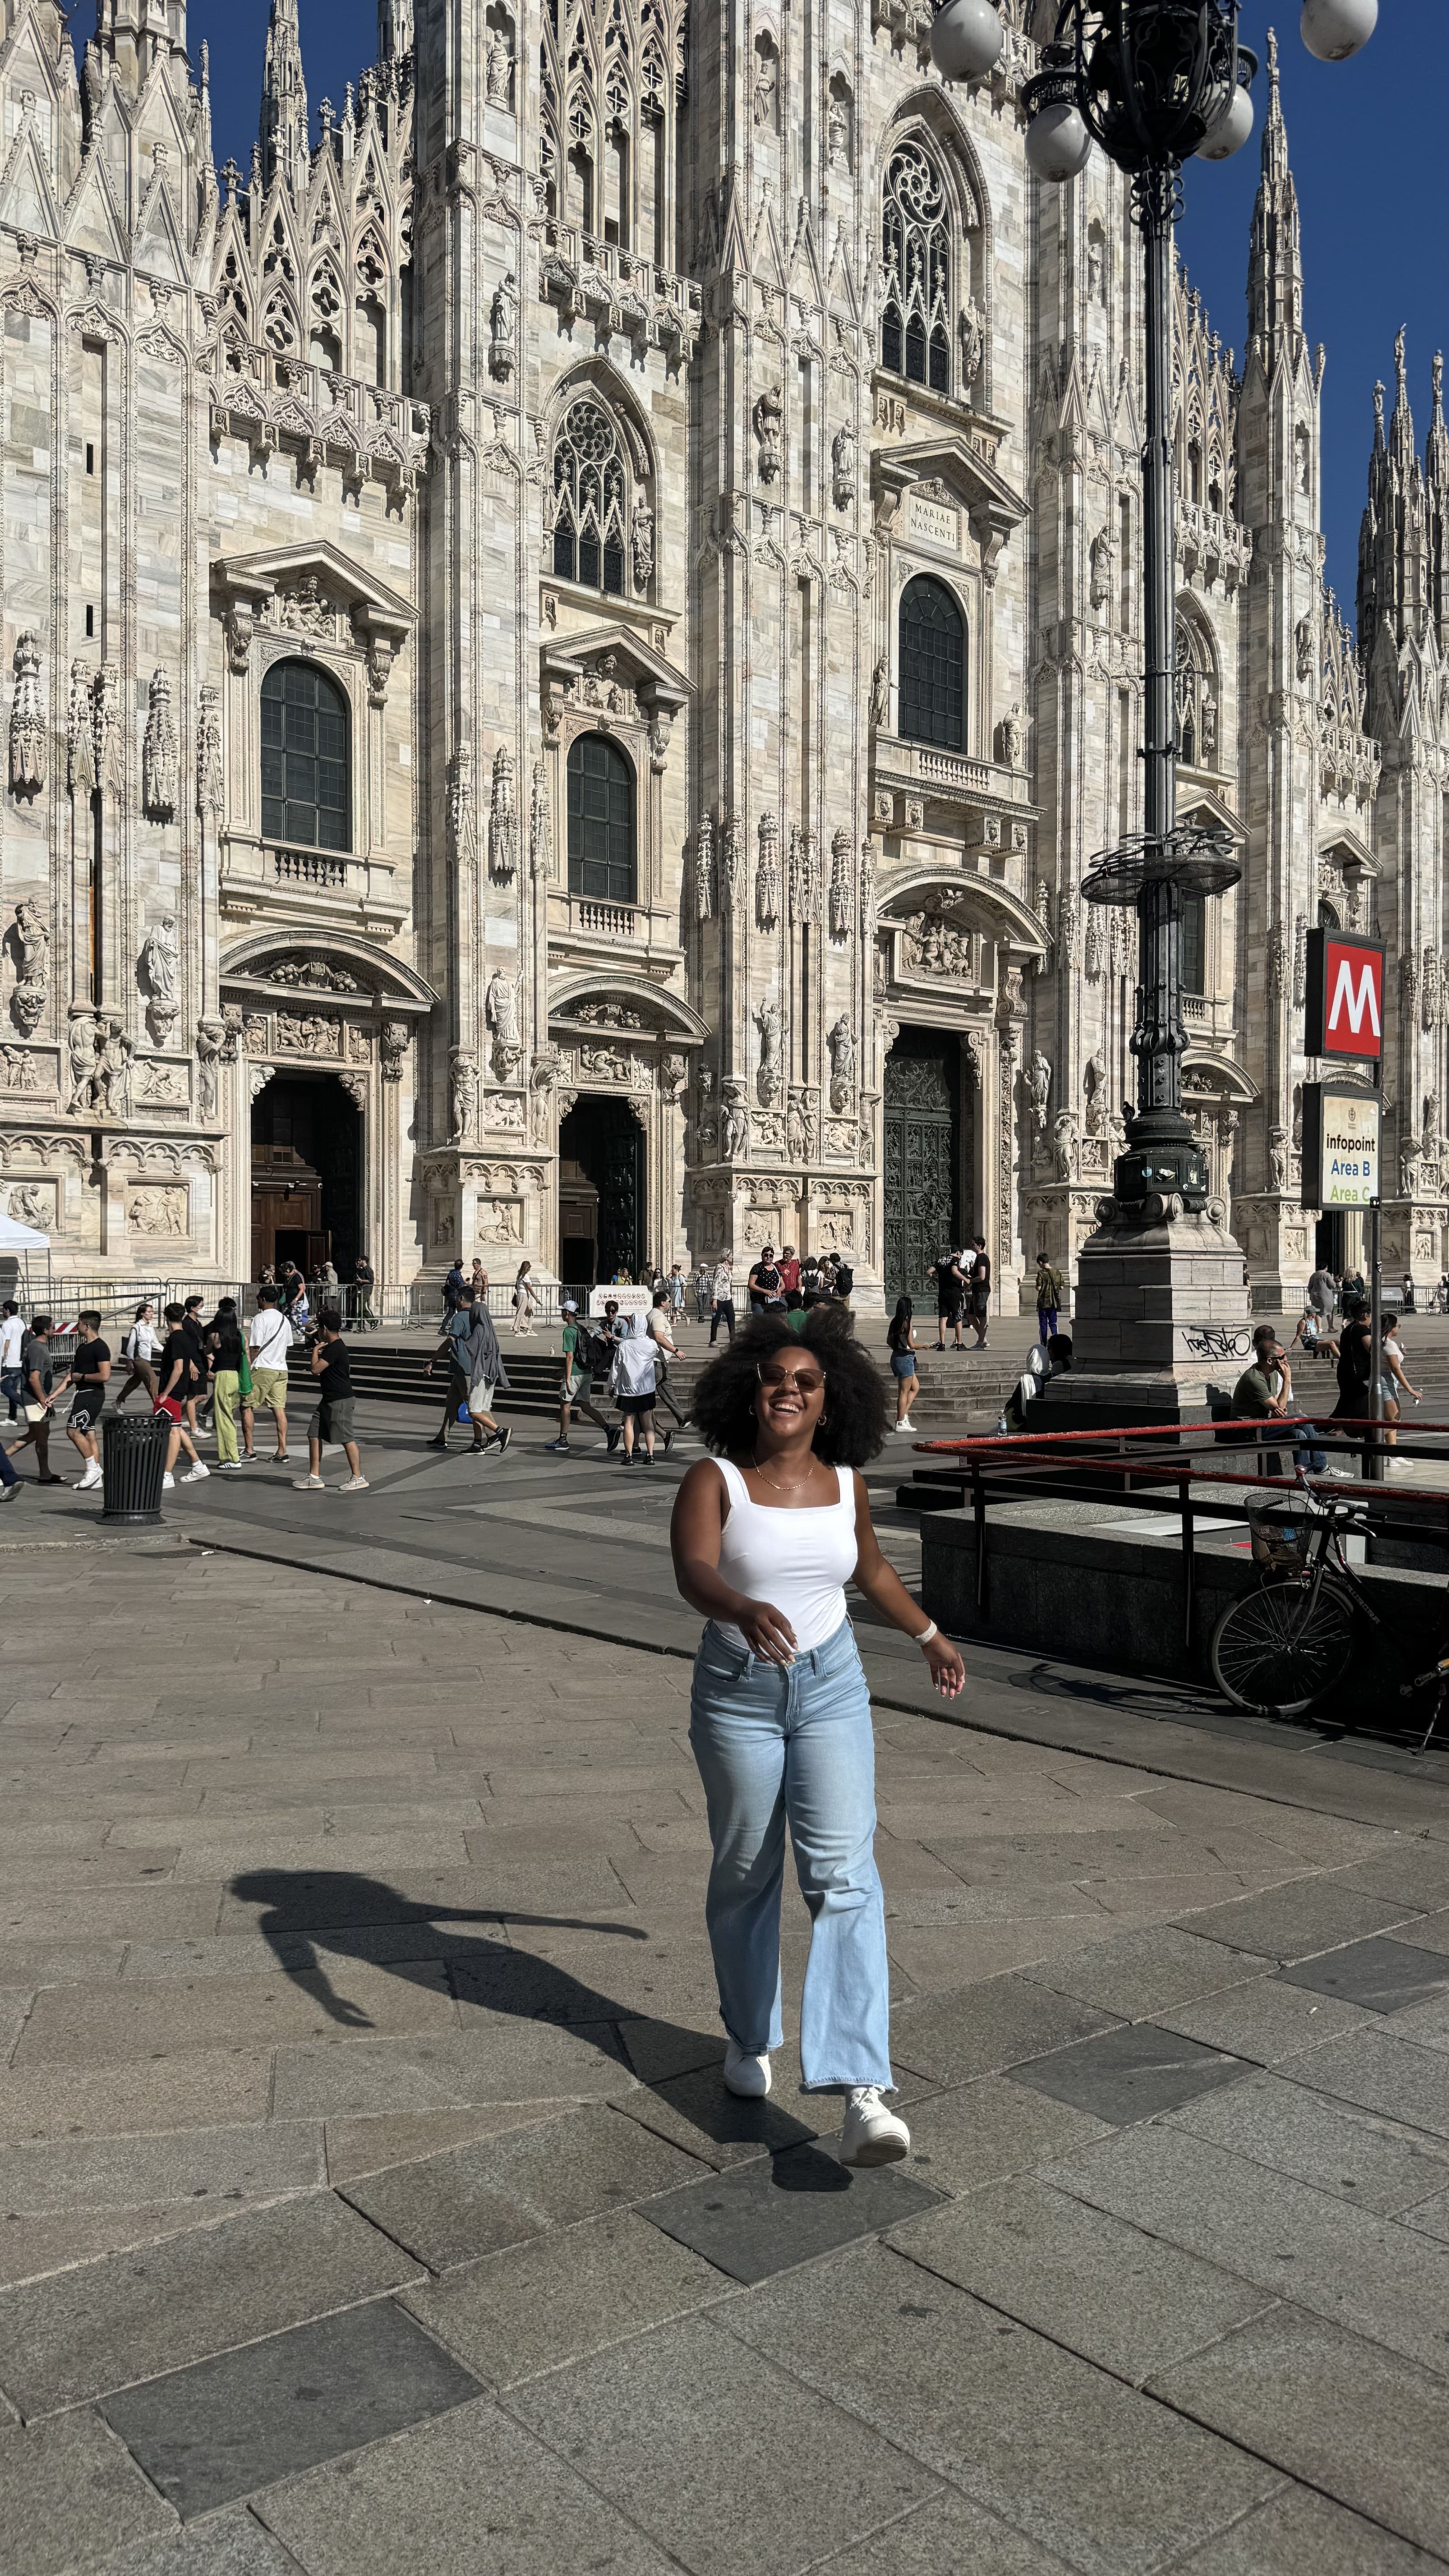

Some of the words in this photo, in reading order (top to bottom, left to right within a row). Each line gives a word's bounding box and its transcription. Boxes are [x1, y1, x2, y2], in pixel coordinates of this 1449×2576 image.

[915, 503, 951, 524] MARIAE
[911, 518, 955, 542] NASCENTI
[1328, 960, 1380, 1037] M
[1326, 1134, 1376, 1153] infopoint
[1331, 1159, 1359, 1176] Area
[1363, 1161, 1371, 1177] B
[1330, 1185, 1358, 1202] Area
[1362, 1186, 1370, 1202] C
